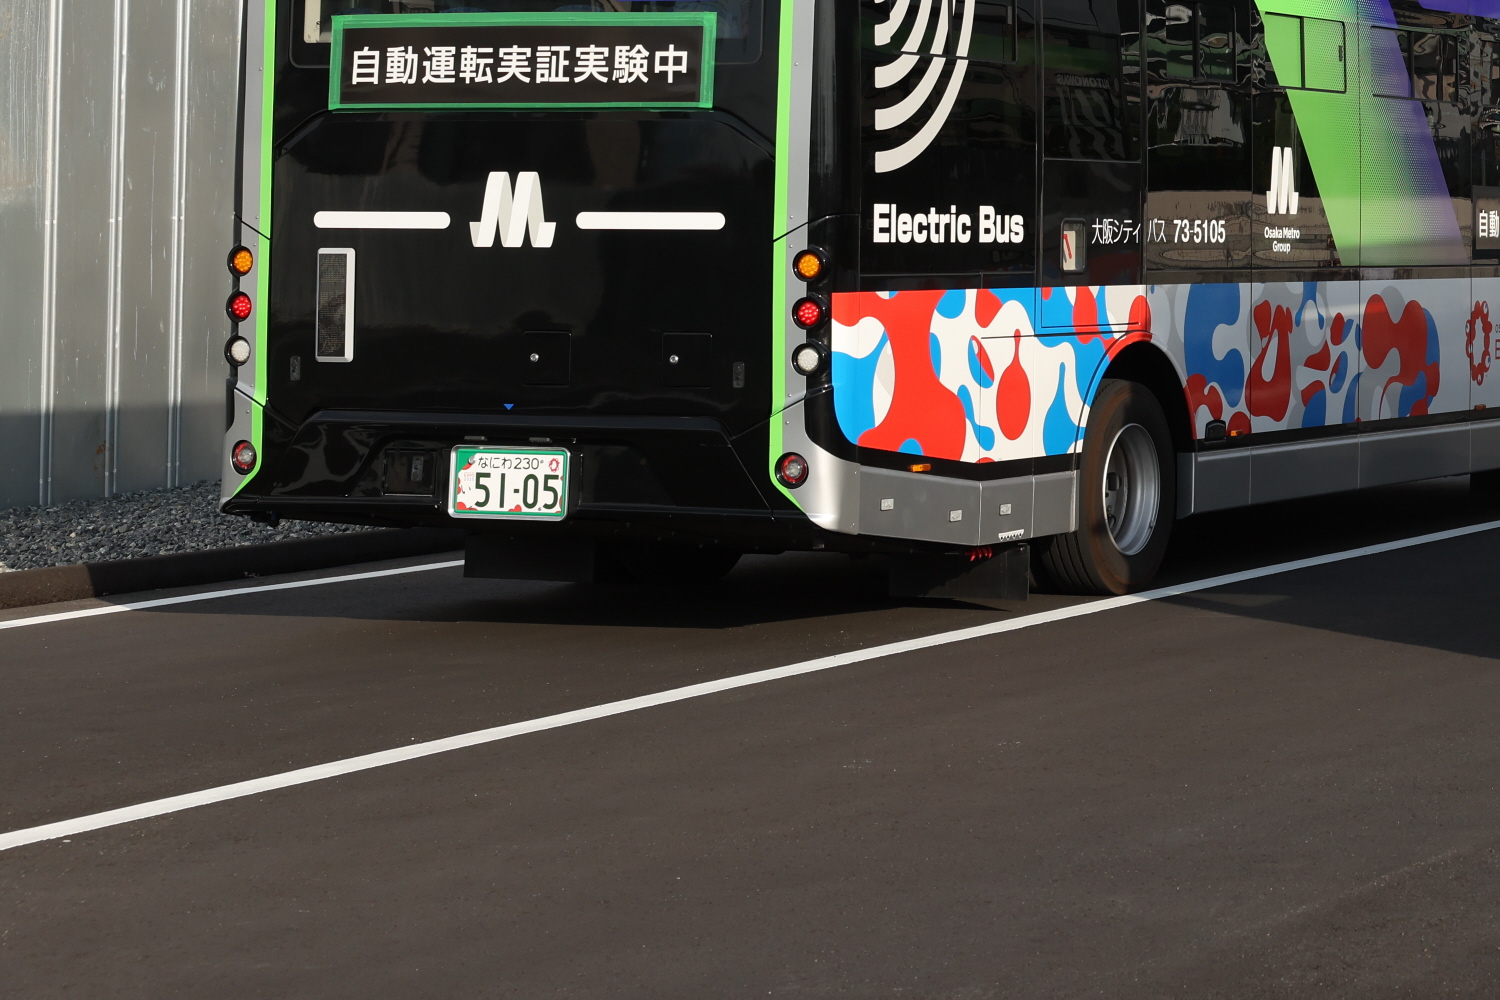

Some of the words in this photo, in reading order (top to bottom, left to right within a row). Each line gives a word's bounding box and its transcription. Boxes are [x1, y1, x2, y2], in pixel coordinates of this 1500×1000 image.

[351, 44, 689, 85] 自動運転実証実験中
[873, 203, 972, 244] Electric
[978, 205, 1025, 244] Bus
[1173, 219, 1226, 244] 73-5105
[1264, 226, 1283, 239] Osaka
[1283, 227, 1301, 239] Metro
[1272, 240, 1291, 255] Group
[460, 485, 472, 495] い
[475, 472, 560, 510] 51-05
